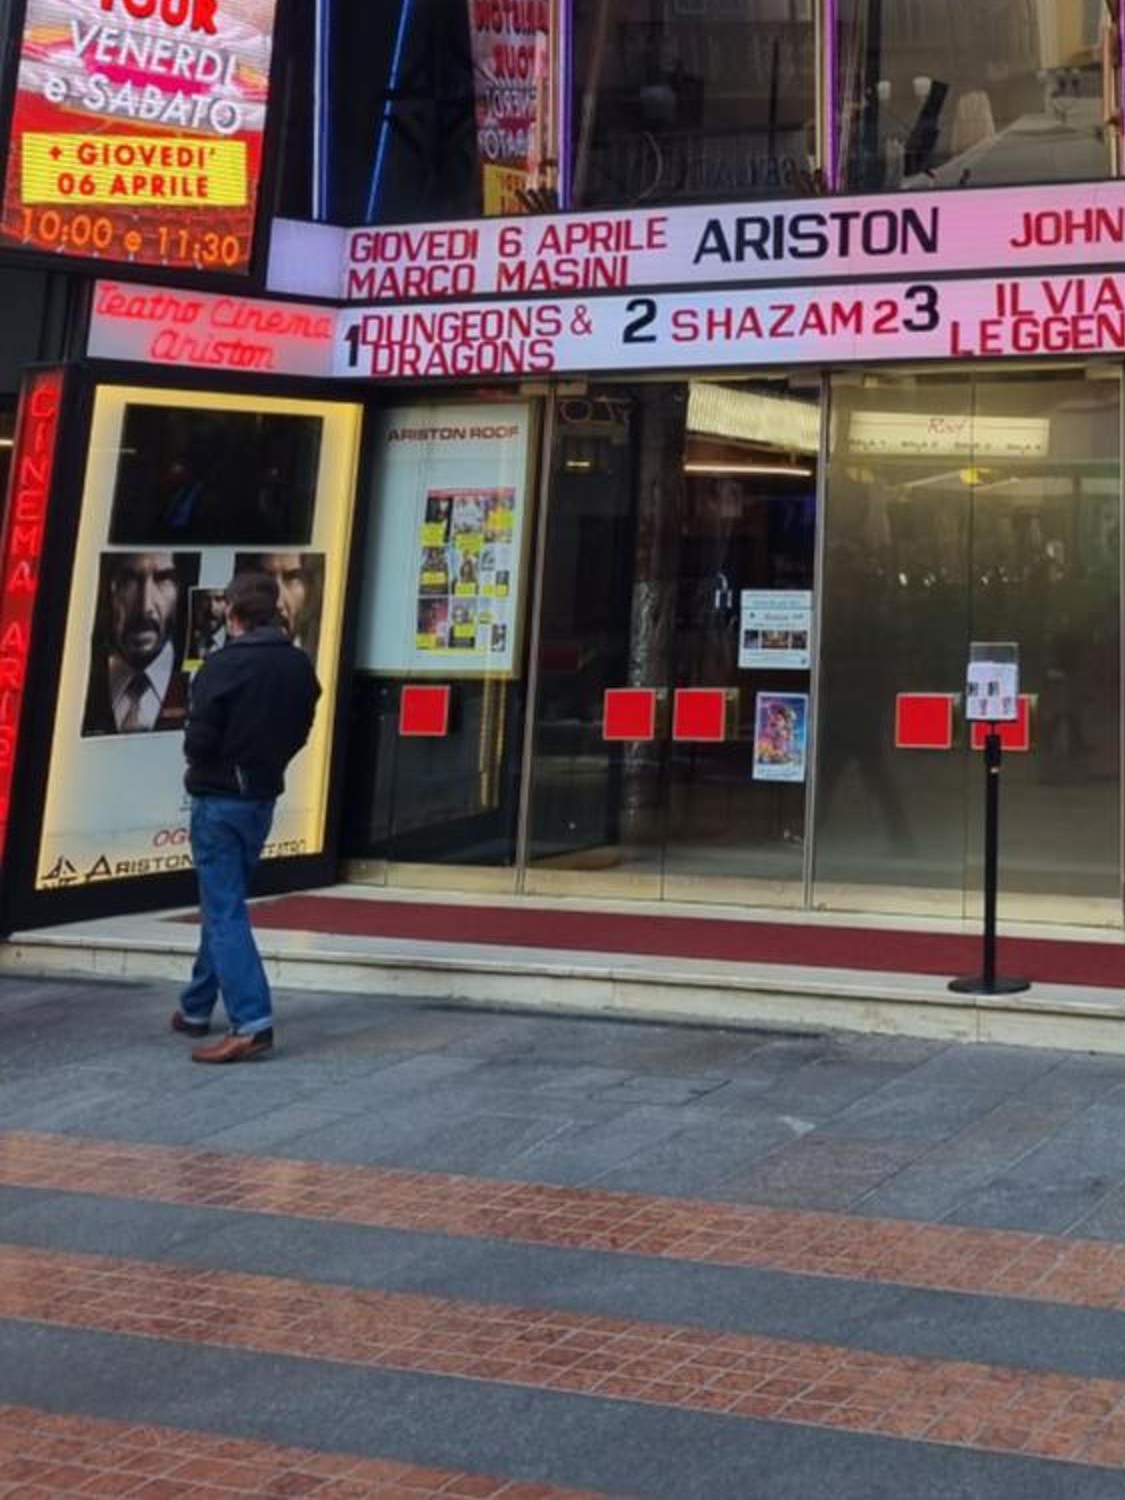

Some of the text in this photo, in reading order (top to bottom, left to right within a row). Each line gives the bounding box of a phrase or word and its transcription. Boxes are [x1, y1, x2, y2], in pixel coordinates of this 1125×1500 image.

[43, 72, 243, 135] e SABATO
[77, 142, 217, 169] GIOVEDI'
[56, 174, 209, 199] 06 APRILE
[20, 206, 240, 267] 10:00 e 11:30
[350, 217, 669, 263] GIOVEDI 6 APRILE
[692, 206, 939, 265] ARISTON
[1010, 206, 1125, 249] JOHN
[347, 257, 629, 300] MARCO MASINI
[96, 283, 333, 340] Teatro Cinema
[622, 297, 658, 344] 2
[344, 323, 361, 367] 1
[370, 339, 556, 377] DRAGONS
[388, 424, 520, 442] ARISTON ROOF
[8, 387, 60, 592] CINEMA
